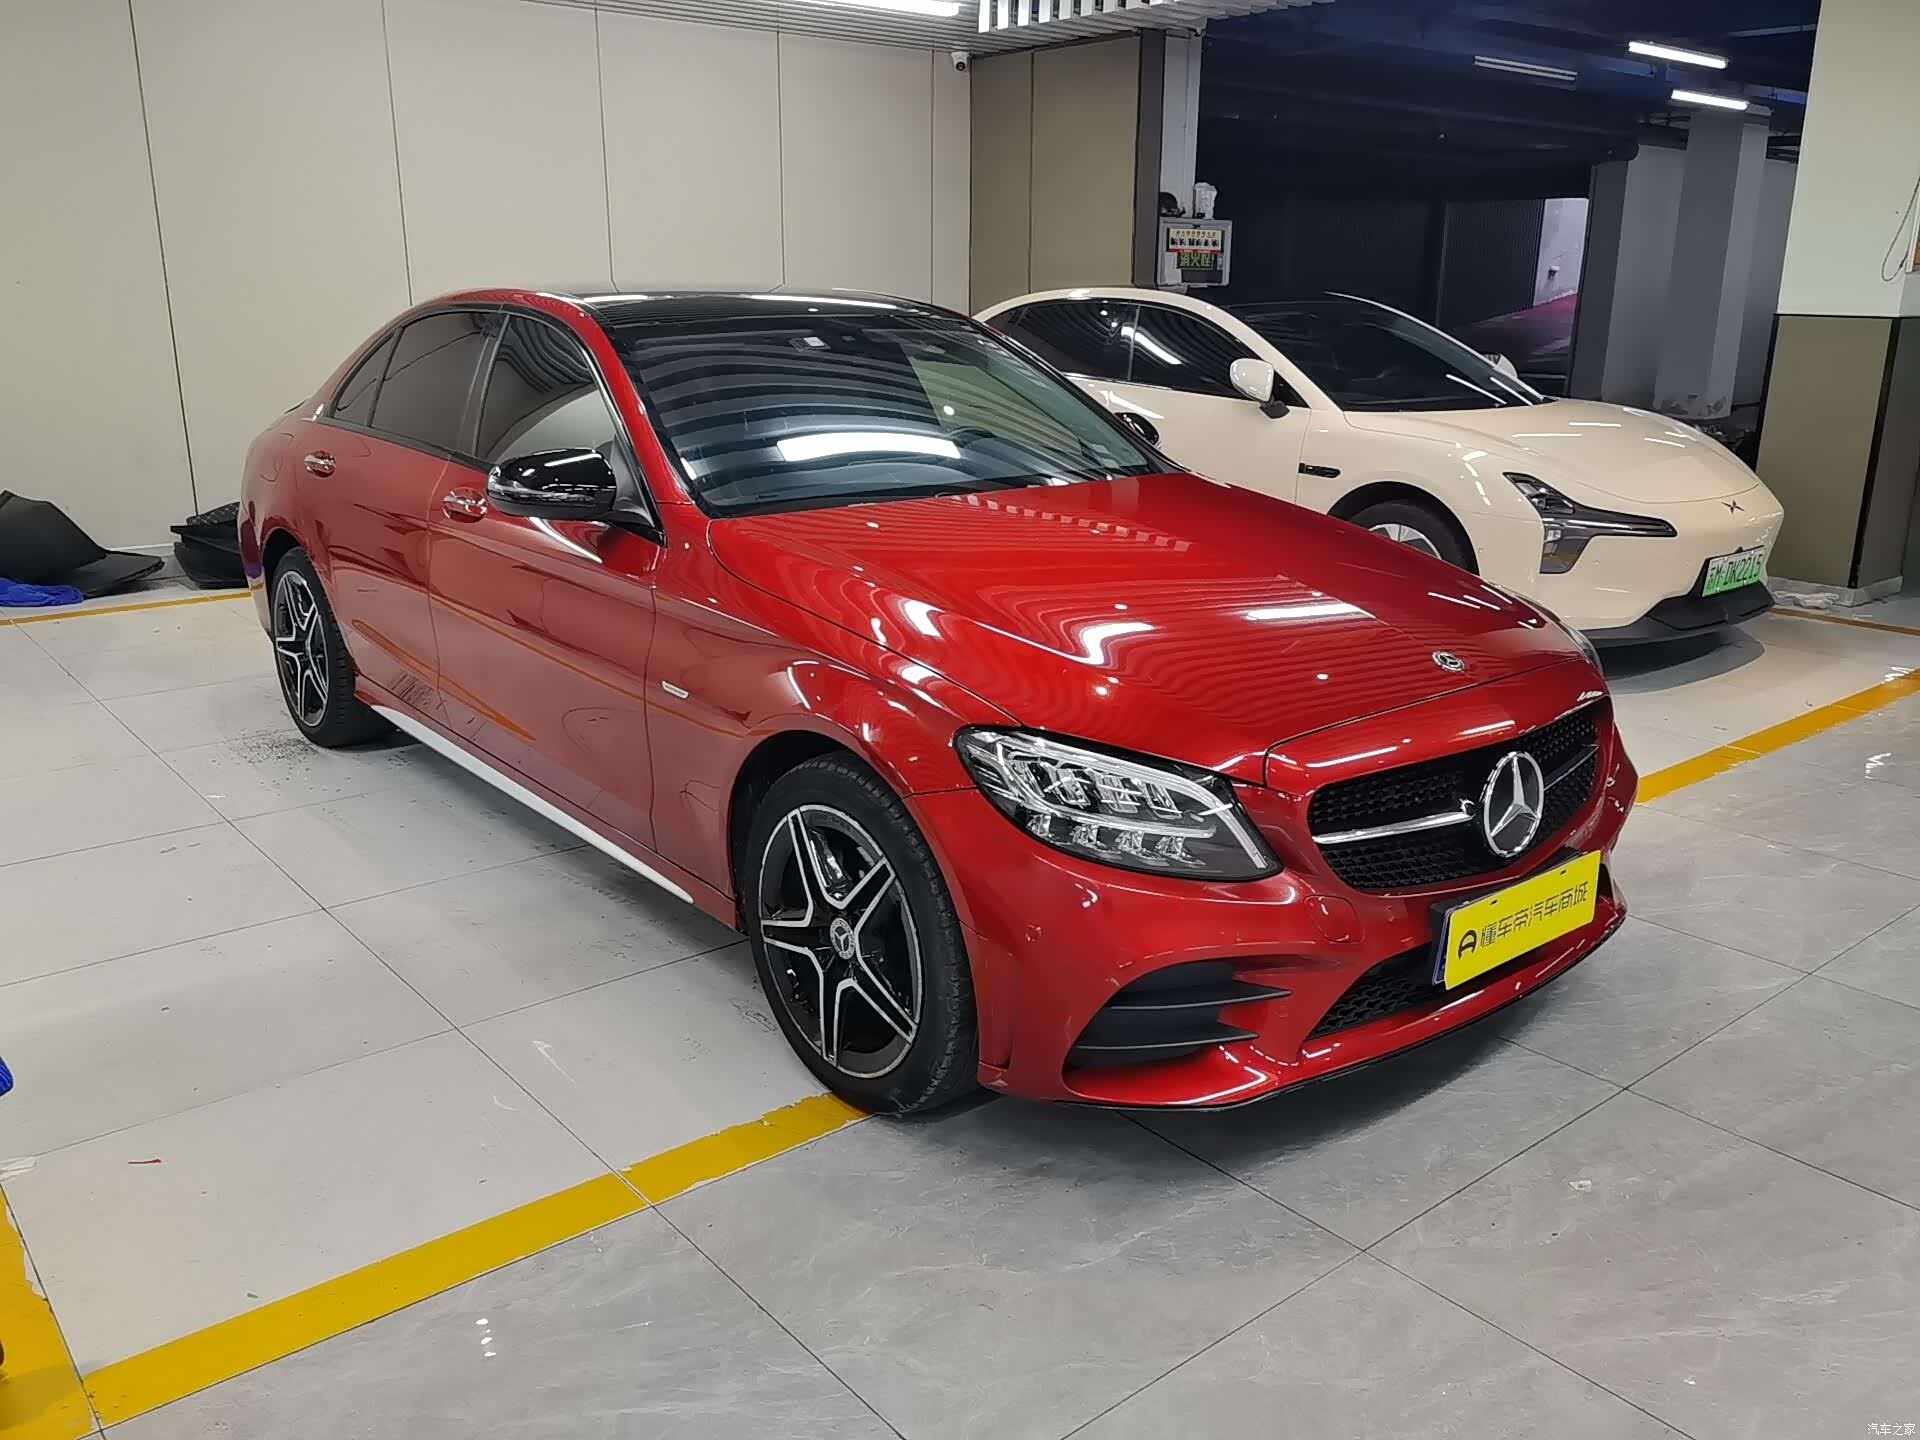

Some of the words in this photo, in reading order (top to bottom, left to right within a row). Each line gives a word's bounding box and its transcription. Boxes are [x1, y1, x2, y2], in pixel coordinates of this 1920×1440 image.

[1480, 881, 1589, 948] 懂车帝汽车商城
